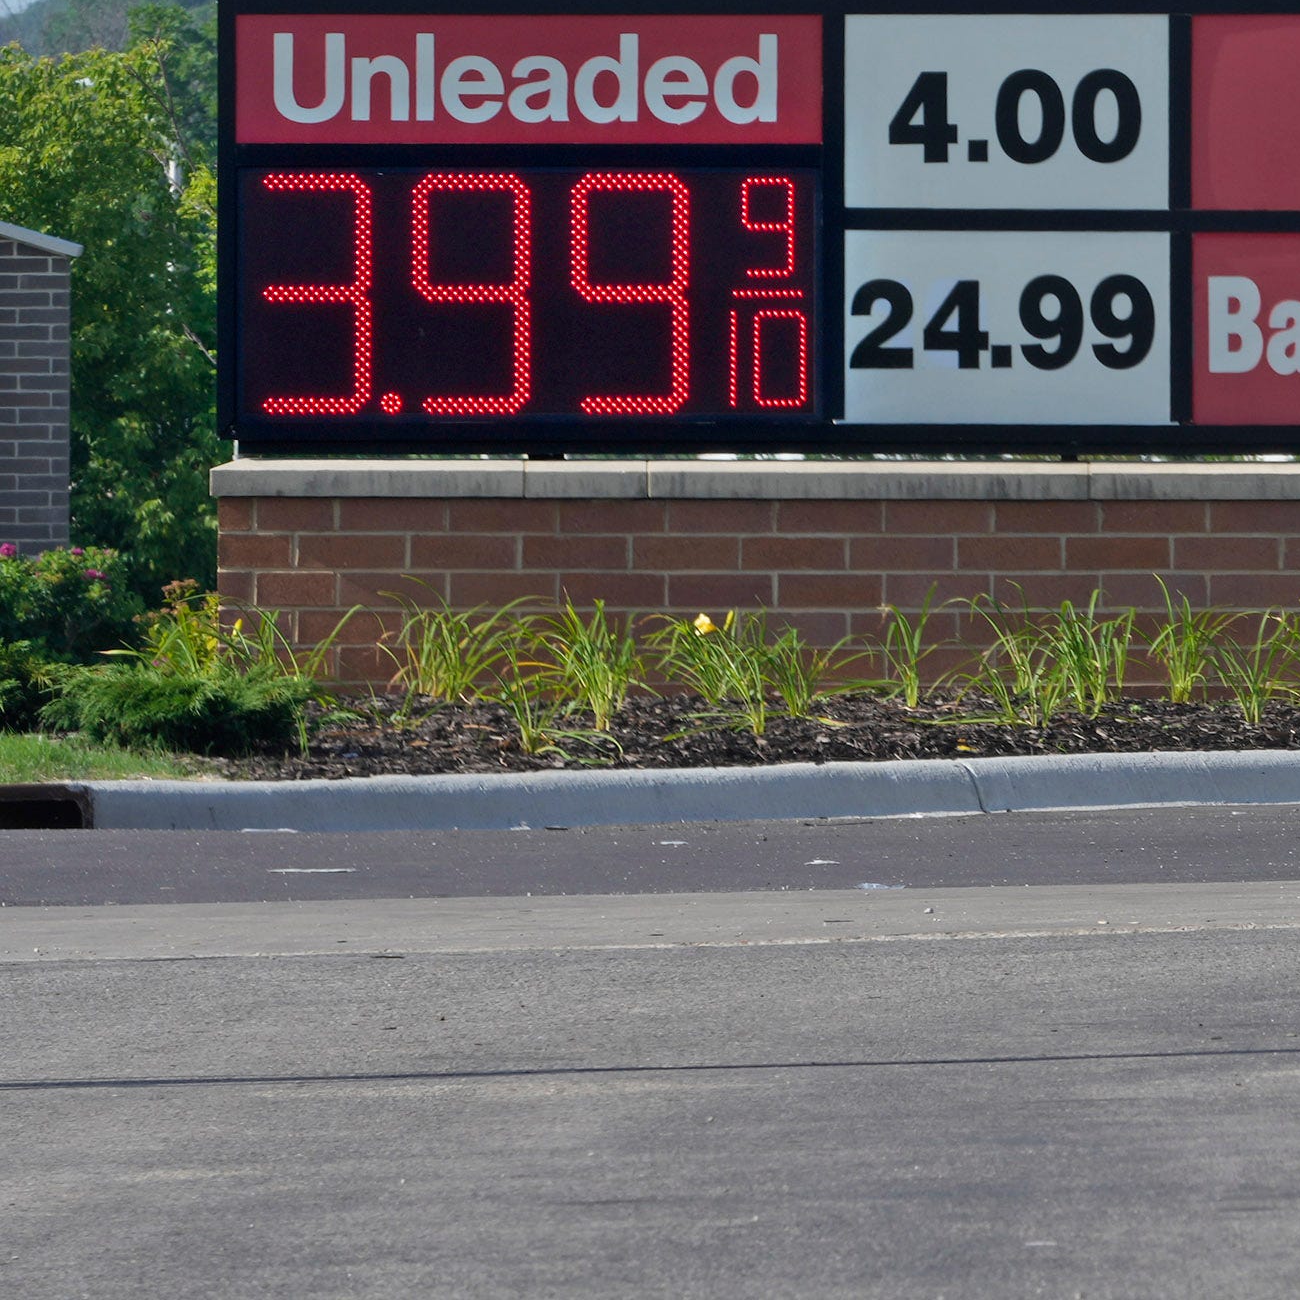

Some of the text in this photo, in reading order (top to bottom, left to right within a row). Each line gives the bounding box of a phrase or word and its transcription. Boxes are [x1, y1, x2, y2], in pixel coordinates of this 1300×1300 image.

[273, 32, 778, 126] Unleaded
[888, 68, 1142, 165] 4.00
[262, 172, 690, 416] 3.99
[850, 274, 1156, 371] 24.99
